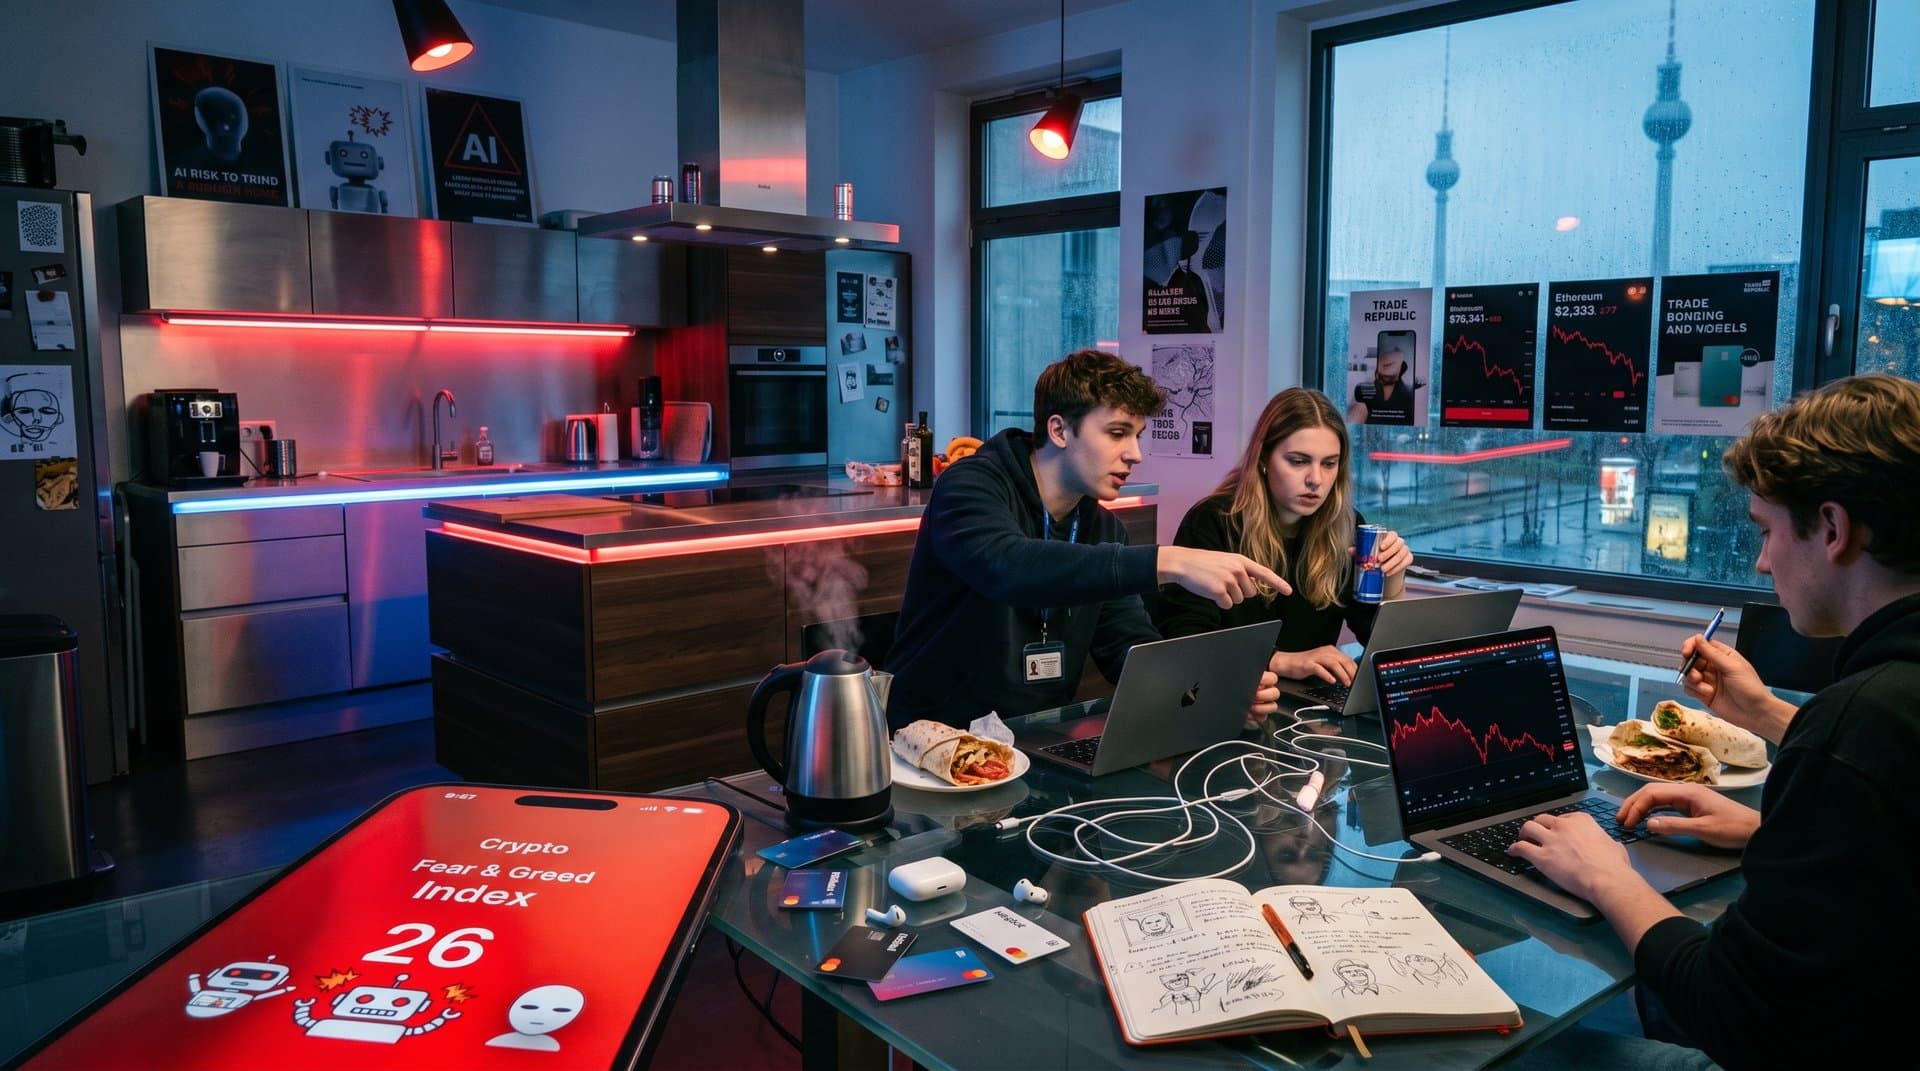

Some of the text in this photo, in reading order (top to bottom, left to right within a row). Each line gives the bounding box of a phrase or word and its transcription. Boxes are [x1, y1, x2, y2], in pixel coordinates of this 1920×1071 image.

[462, 133, 499, 165] AI
[174, 167, 279, 186] AI RISK TO TRIND
[1372, 300, 1408, 310] TRADE
[1555, 293, 1603, 302] Ethereum
[1667, 298, 1710, 309] TRADE
[1364, 311, 1417, 322] REPUBLIC
[1666, 324, 1693, 335] AND
[480, 837, 569, 855] Crypto
[412, 859, 596, 884] Fear & Greed
[412, 880, 537, 907] Index
[361, 922, 495, 968] 26
